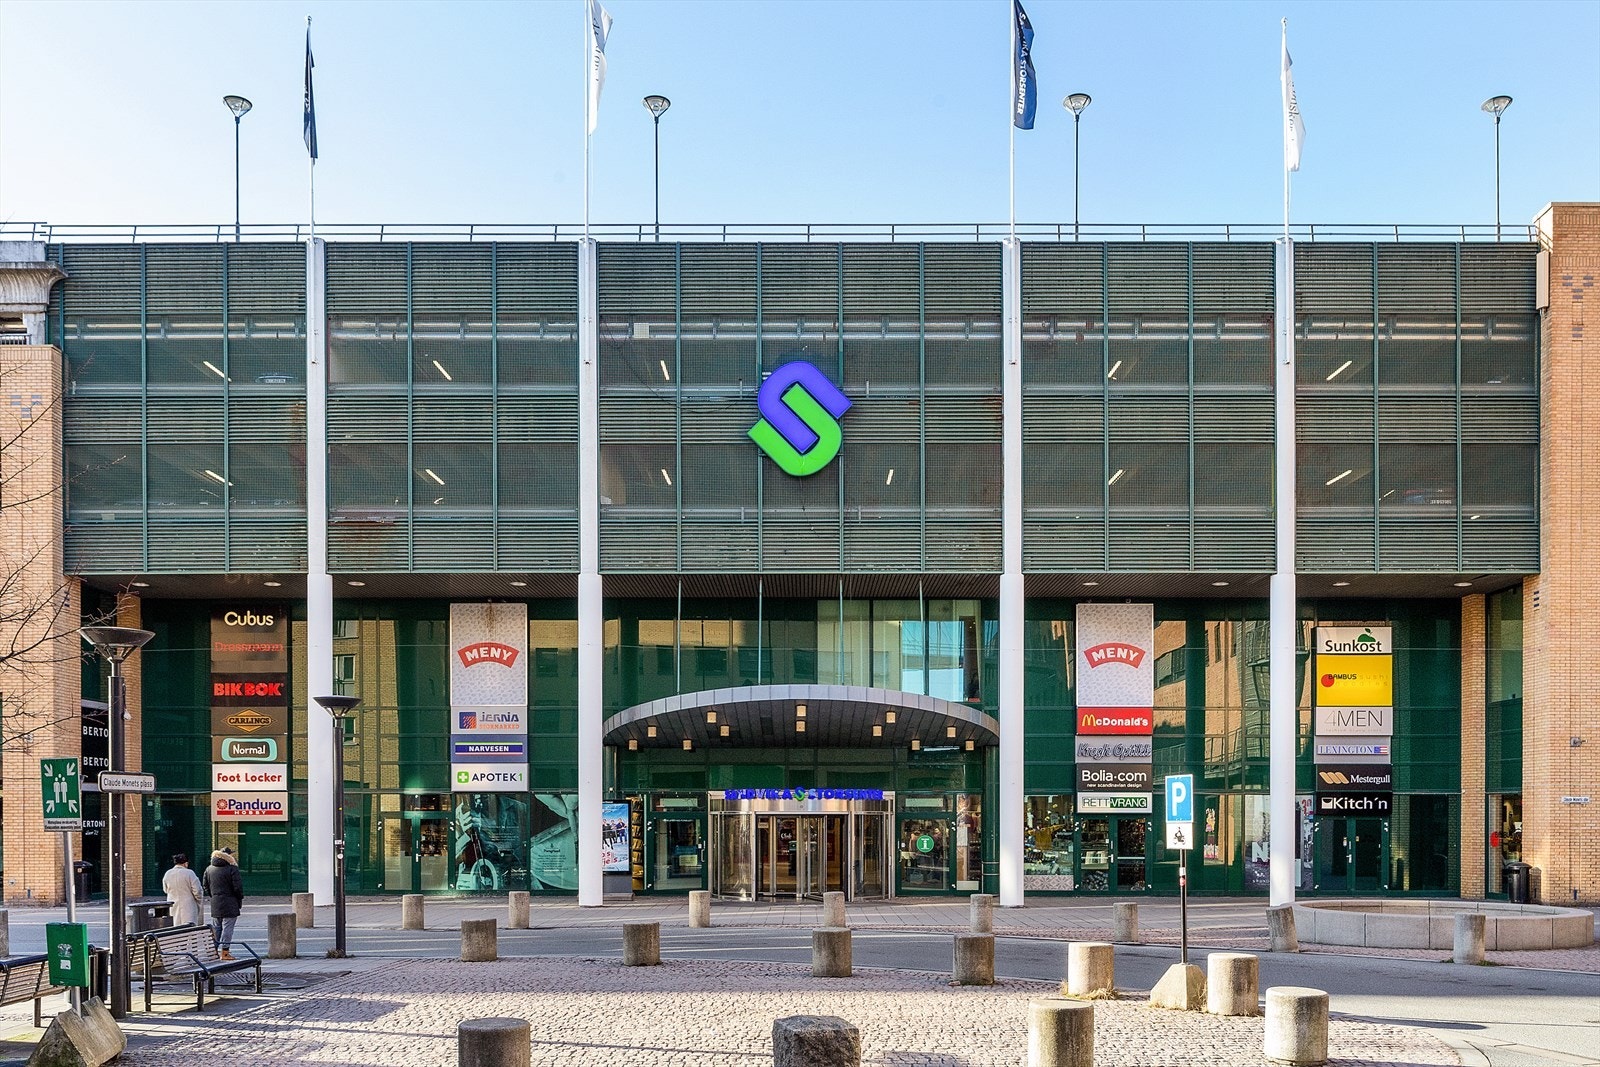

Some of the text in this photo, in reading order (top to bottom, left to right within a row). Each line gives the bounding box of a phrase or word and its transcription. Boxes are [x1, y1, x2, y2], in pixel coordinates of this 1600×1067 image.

[224, 610, 274, 627] Cubus
[1325, 639, 1382, 652] Sunkost
[465, 646, 513, 662] MENY
[1090, 647, 1140, 662] MENY
[213, 683, 281, 696] BIK BOK
[1082, 714, 1149, 727] McDonald's
[1324, 710, 1383, 727] 4MEN
[82, 726, 109, 738] BERTO
[232, 743, 266, 755] Normal
[1320, 745, 1373, 754] LEXINGTON
[83, 756, 109, 767] BERTO
[103, 777, 152, 789] Claude Monets plass
[217, 772, 282, 783] Foot Locker
[472, 772, 517, 782] APOTEK
[1350, 774, 1390, 785] Mestergull
[228, 798, 282, 810] Panduro
[1171, 781, 1186, 817] P
[82, 820, 106, 828] ERTONI
